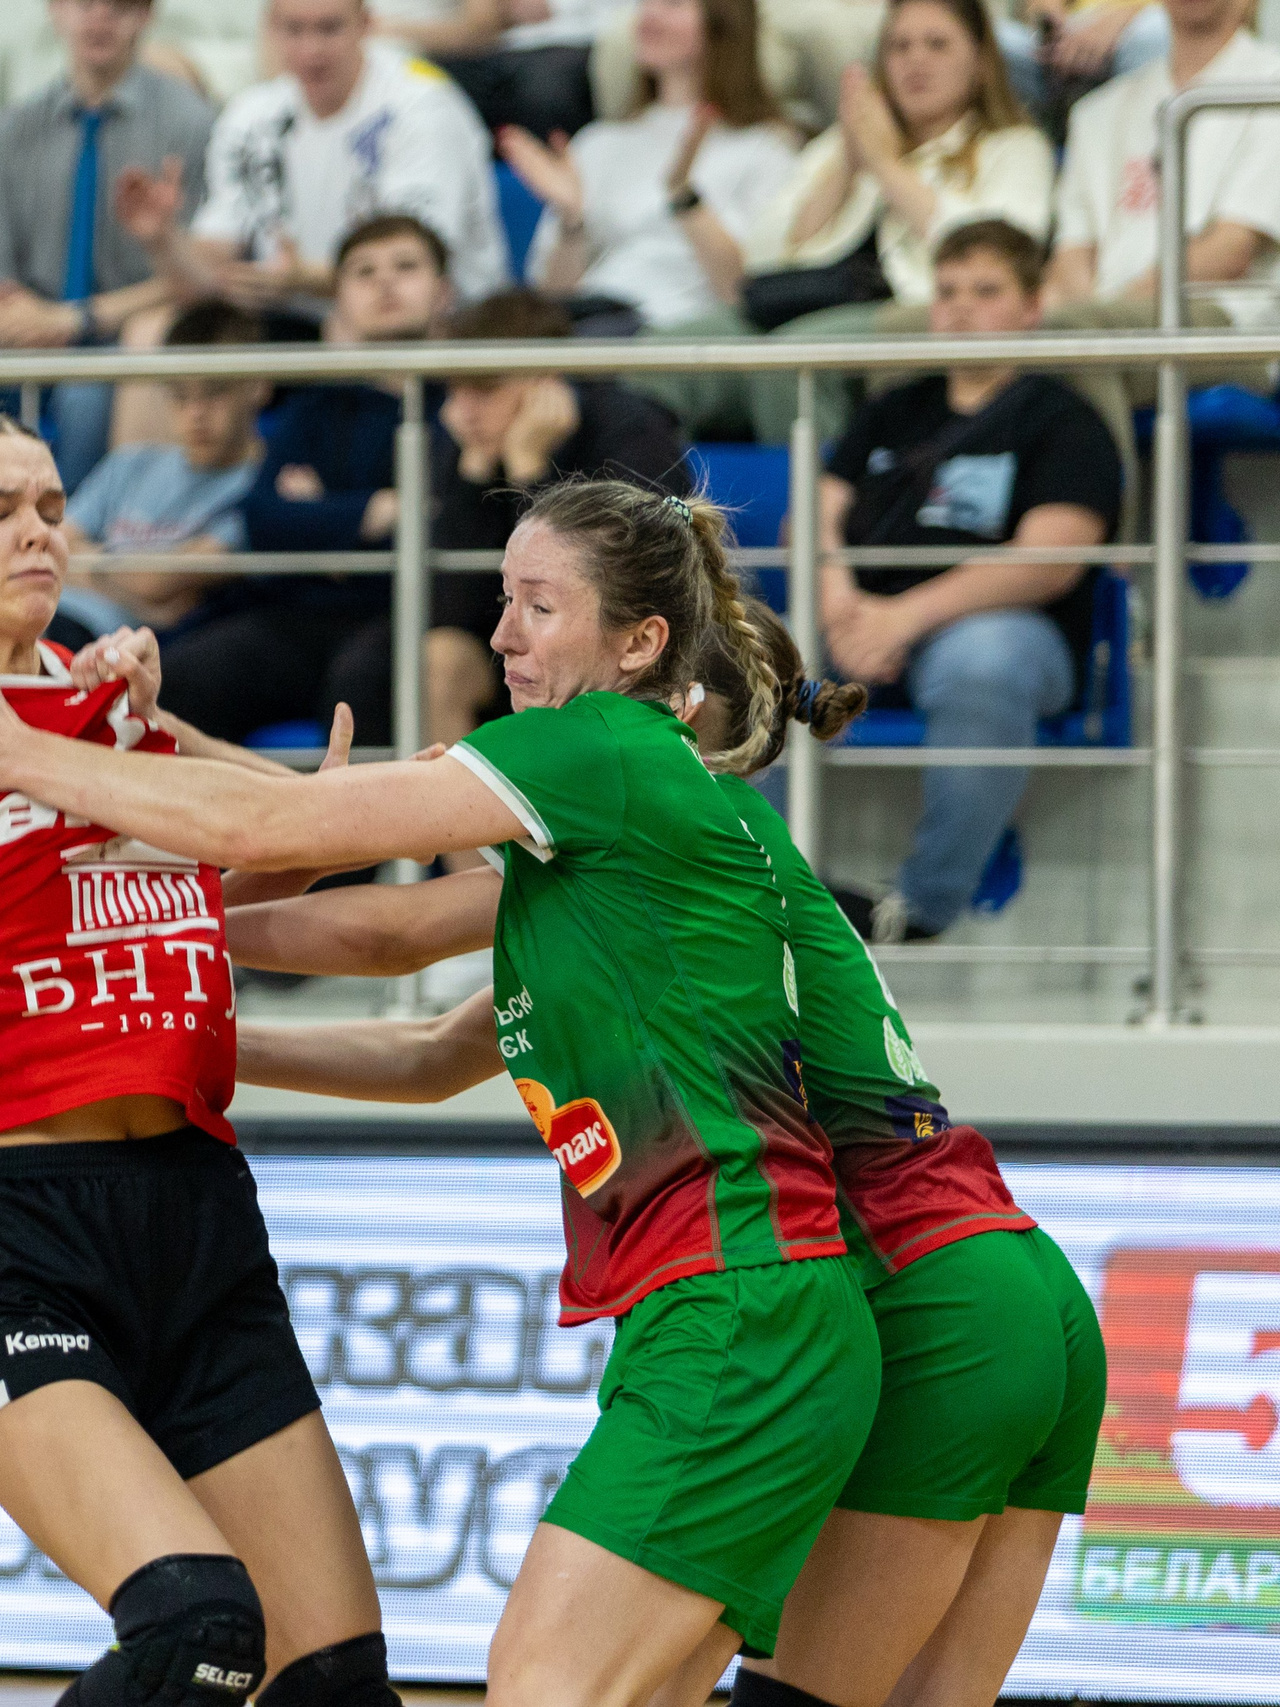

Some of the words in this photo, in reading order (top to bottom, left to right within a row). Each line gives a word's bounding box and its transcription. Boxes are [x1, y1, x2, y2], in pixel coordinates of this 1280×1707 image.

[120, 1011, 197, 1033] 1920
[5, 1331, 90, 1356] Kempa
[194, 1663, 253, 1688] SELECT
